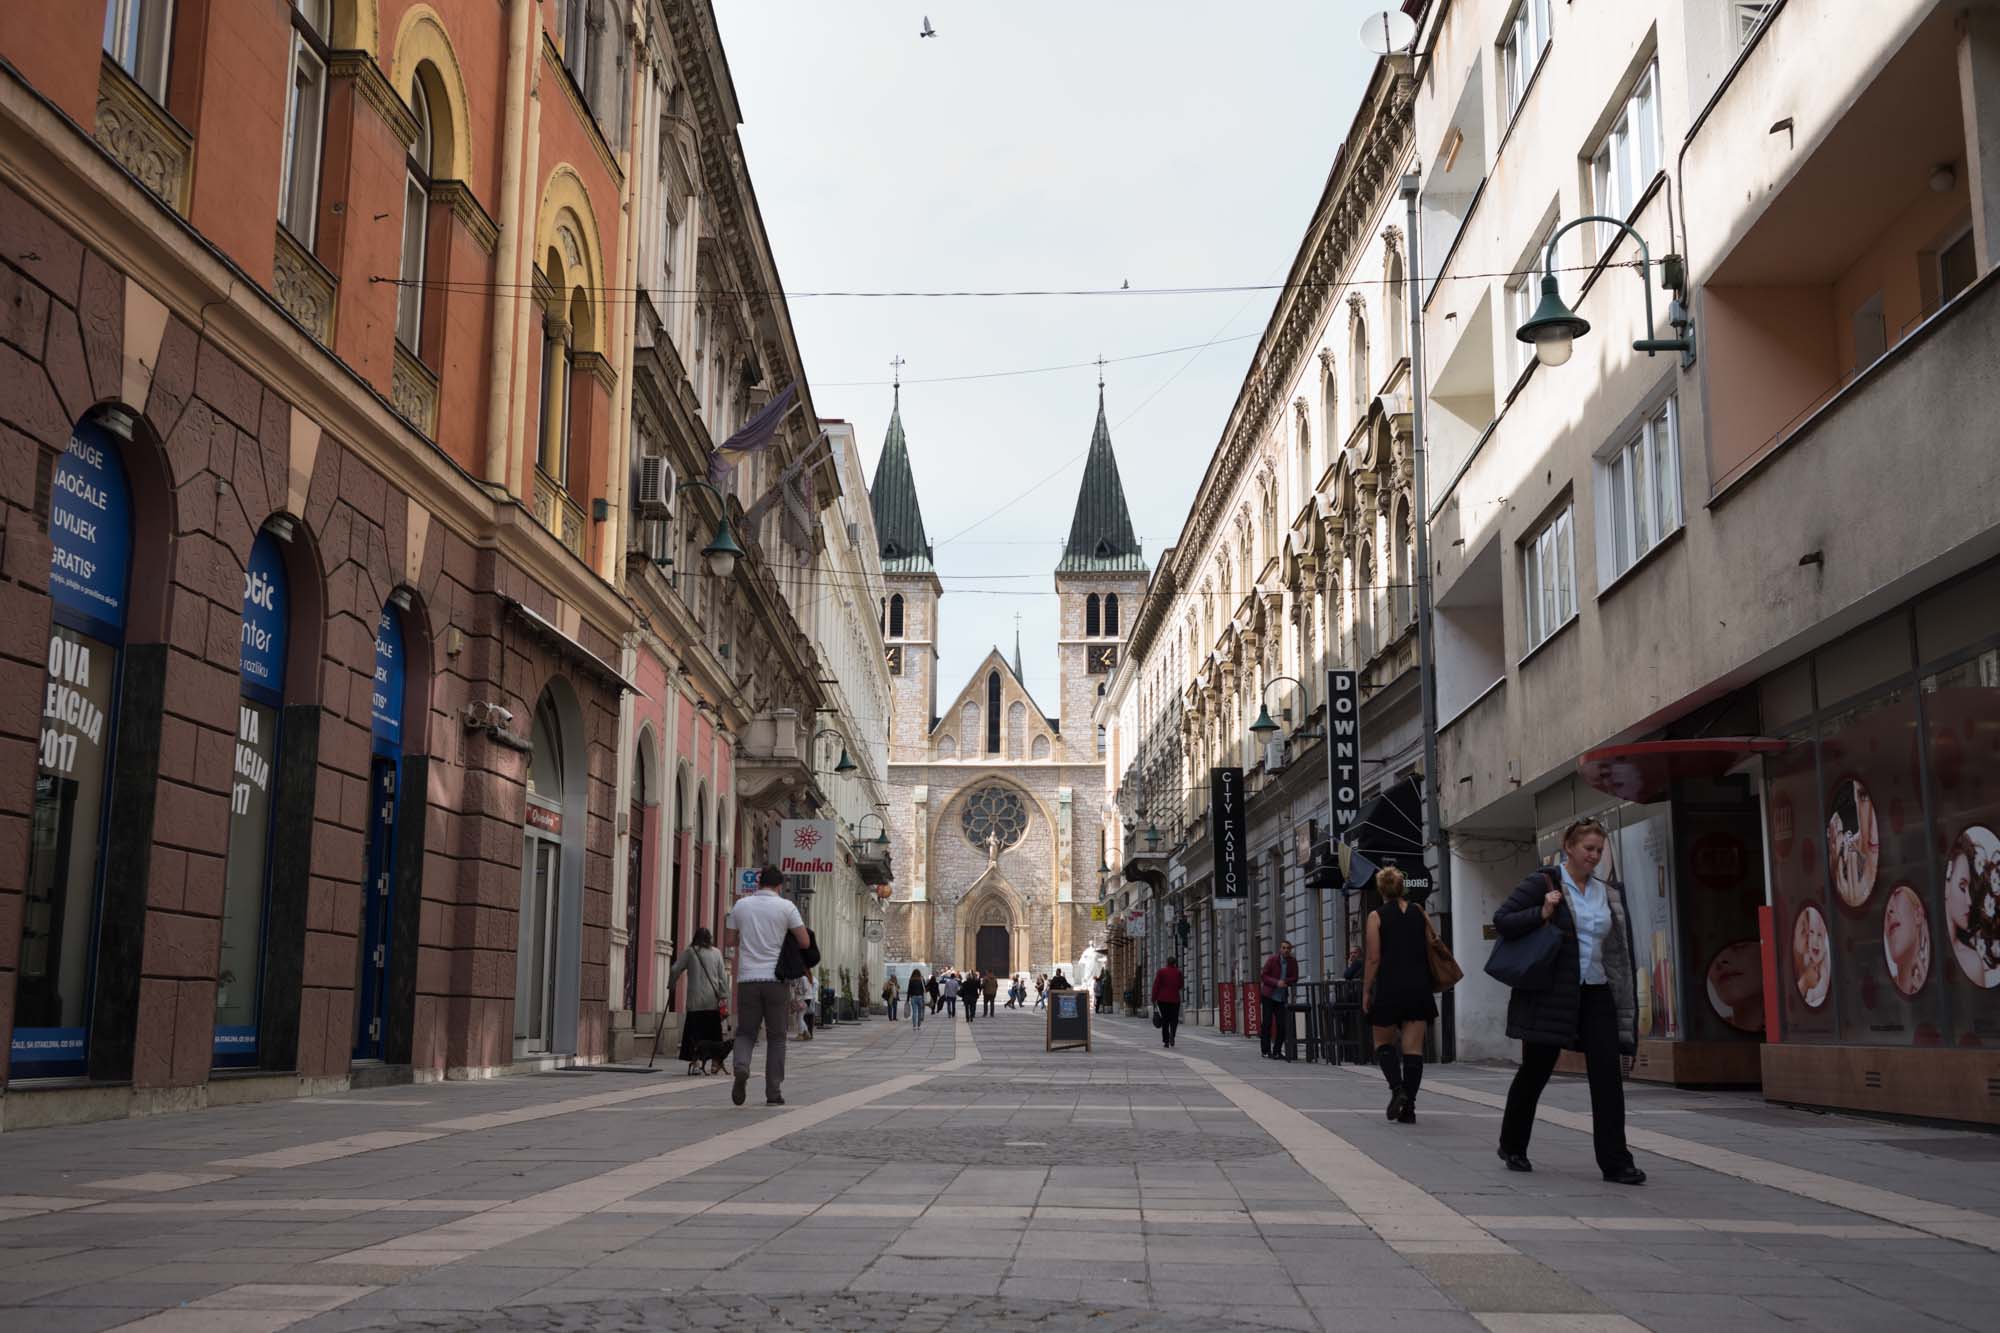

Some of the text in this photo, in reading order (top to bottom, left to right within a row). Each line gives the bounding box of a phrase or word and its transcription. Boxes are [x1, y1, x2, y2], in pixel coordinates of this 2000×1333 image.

[54, 506, 96, 544] UVIJEK
[48, 635, 90, 688] OVA
[43, 682, 103, 745] EKCIJA
[1334, 675, 1357, 843] DOWNTOW
[1222, 772, 1236, 893] CITY FASHION
[781, 857, 833, 872] Planika
